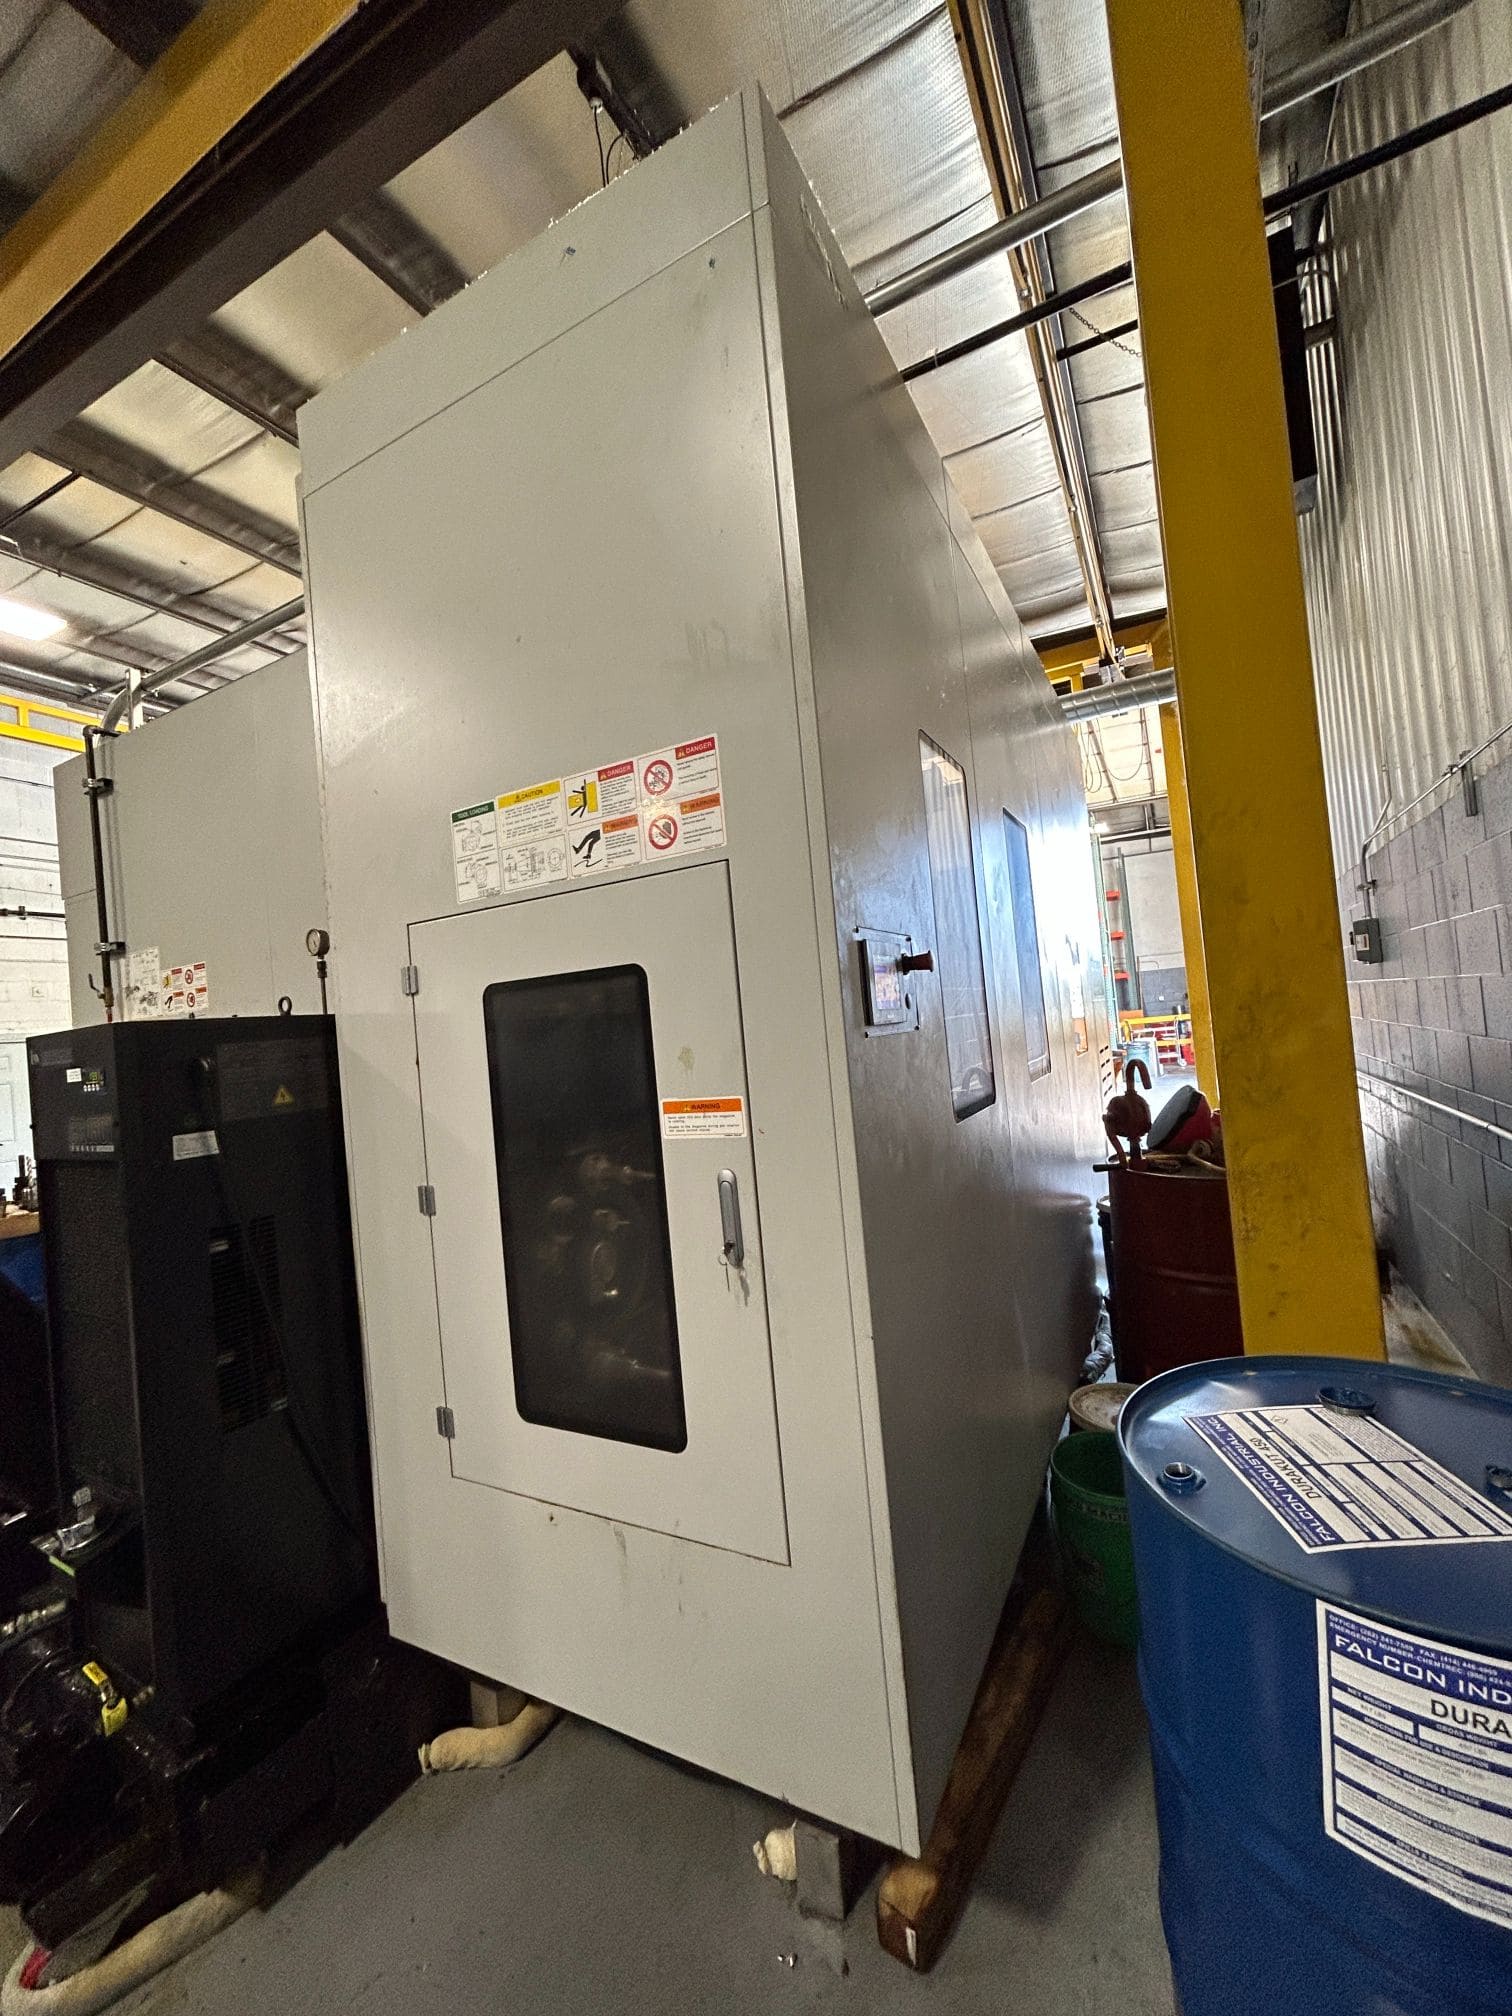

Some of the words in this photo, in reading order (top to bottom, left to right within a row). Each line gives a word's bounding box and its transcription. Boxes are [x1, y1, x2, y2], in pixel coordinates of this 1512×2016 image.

[686, 742, 712, 754] DANGER
[607, 766, 631, 776] DANGER
[469, 805, 488, 817] LOADING
[521, 790, 543, 799] CAUTION
[1266, 1453, 1322, 1498] DURAKUT
[1282, 1494, 1336, 1541] FALCON
[1329, 1621, 1377, 1646] EMERGENCY
[1336, 1634, 1445, 1688] FALCON
[1459, 1679, 1512, 1706] IND
[1347, 1687, 1361, 1698] NET
[1363, 1694, 1392, 1711] WEIGHT
[1466, 1733, 1497, 1748] WEIGHT
[1431, 1698, 1512, 1739] DURA
